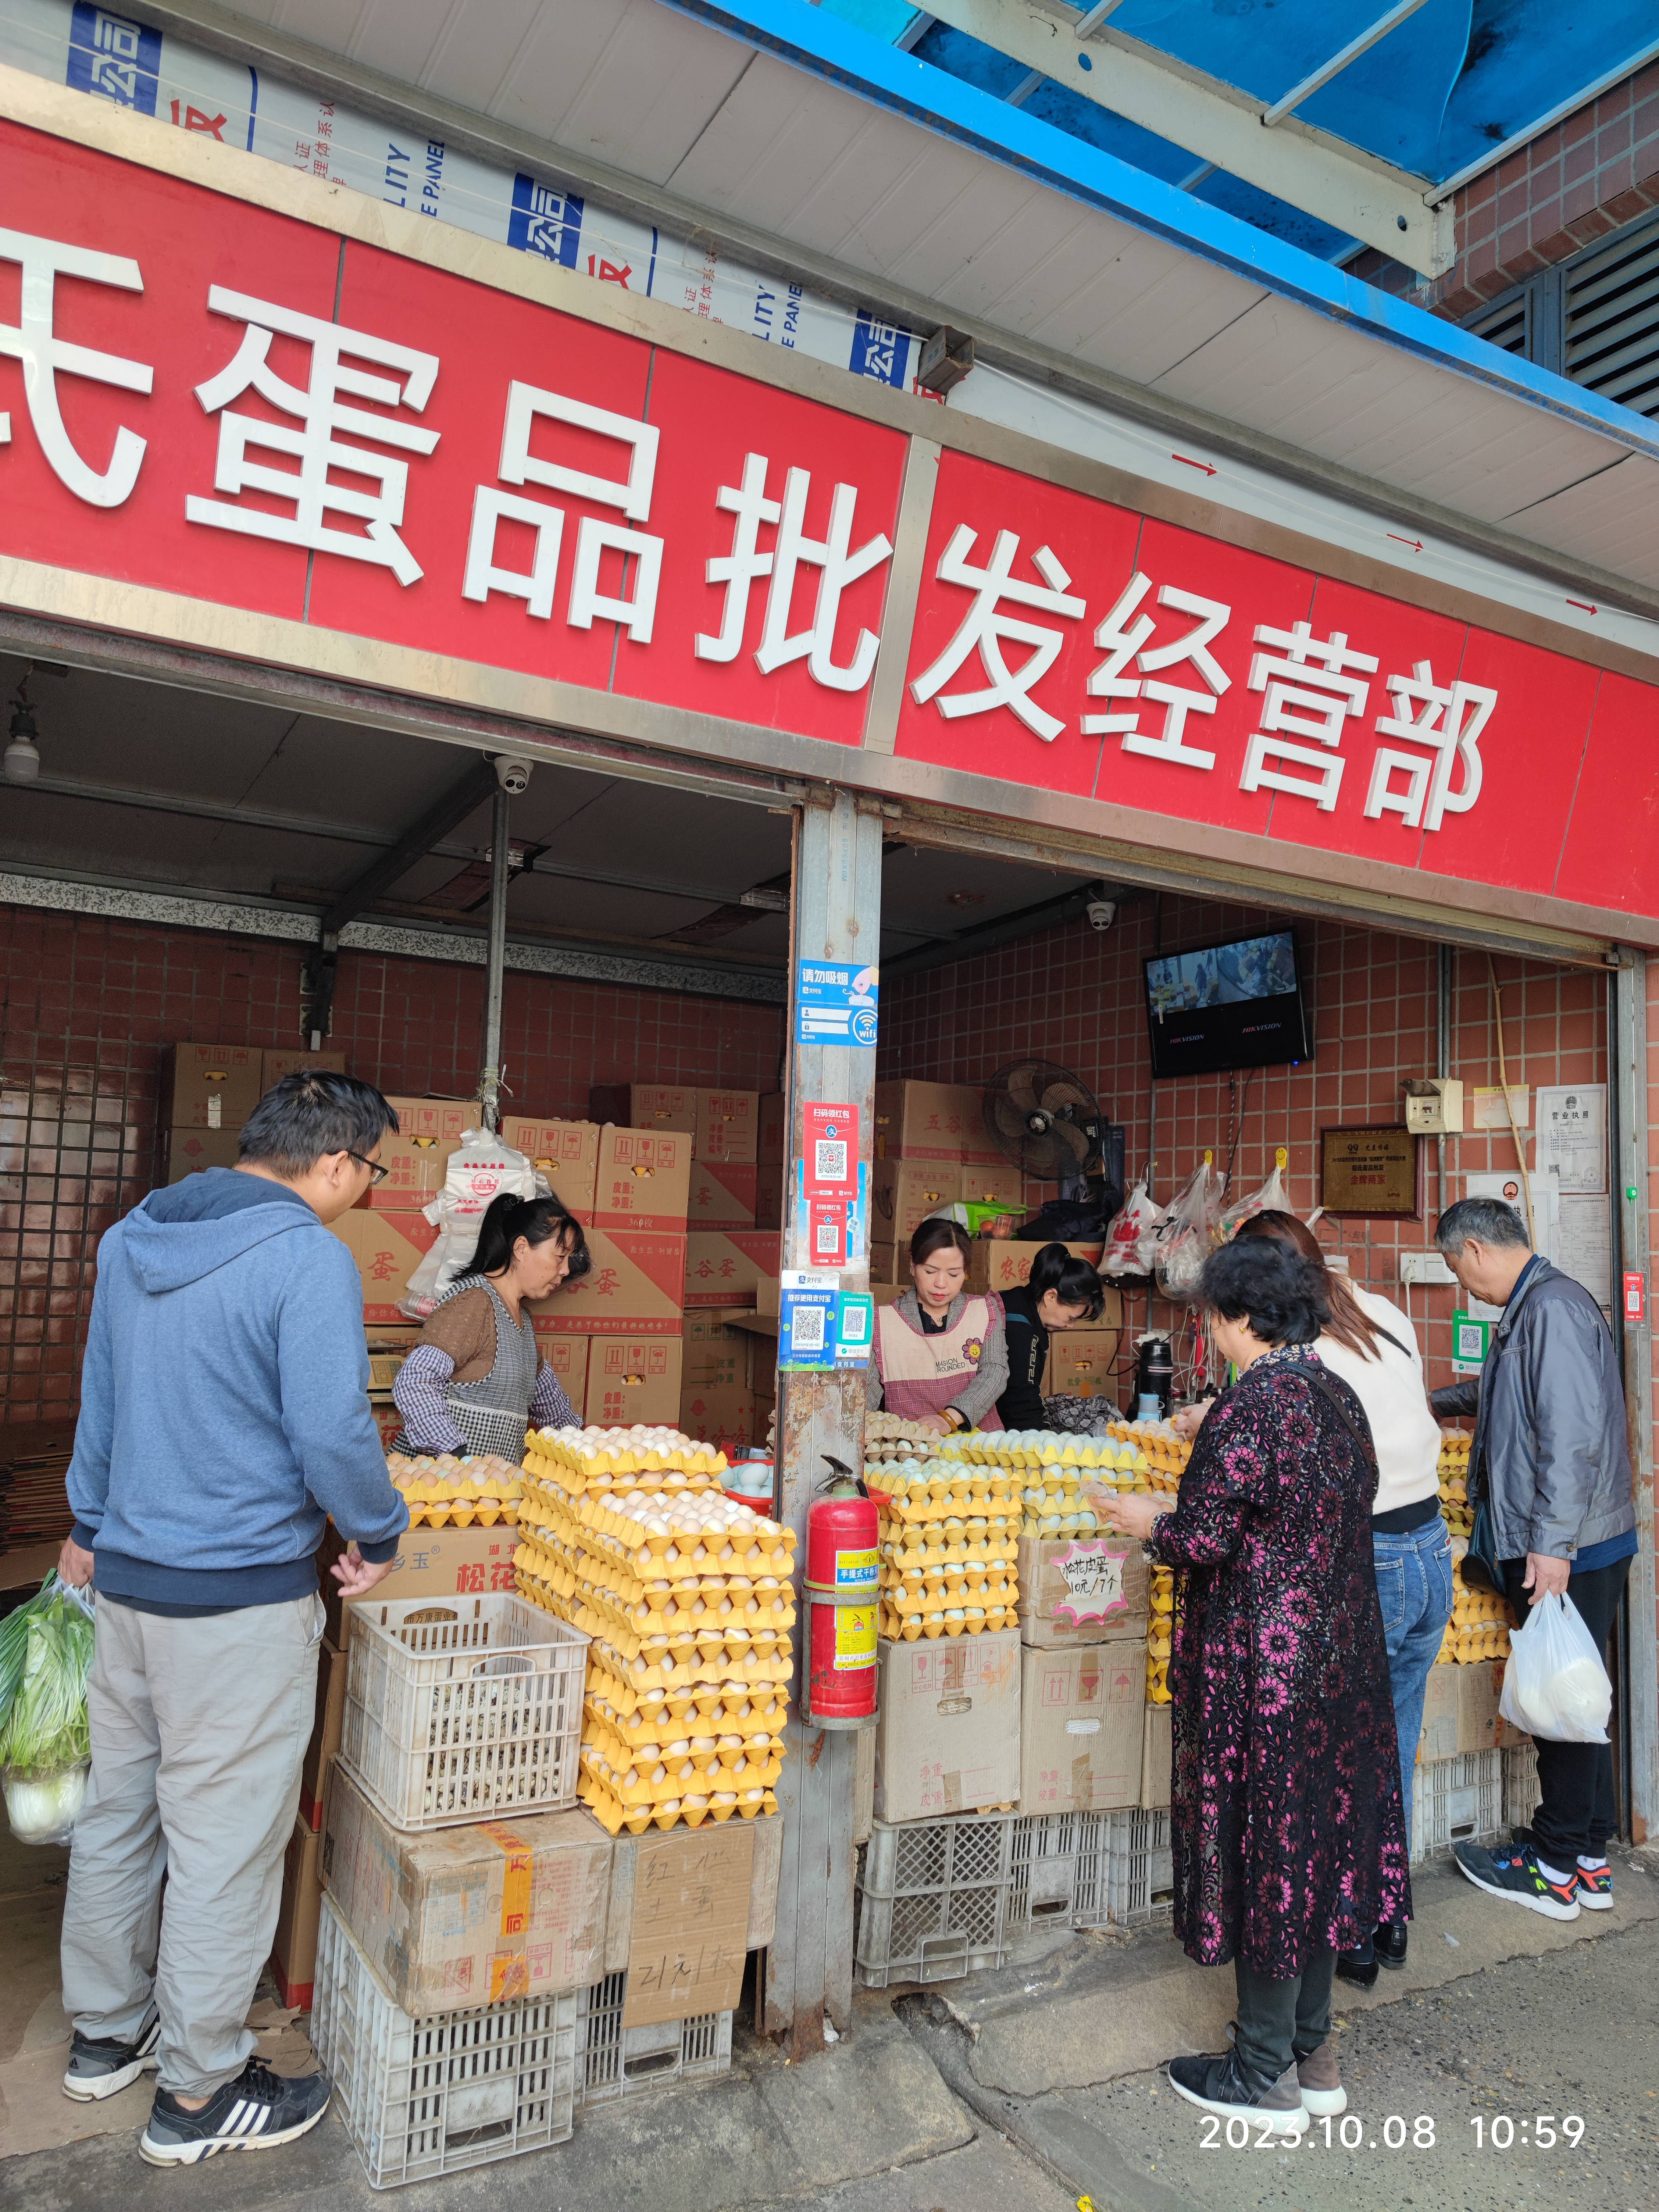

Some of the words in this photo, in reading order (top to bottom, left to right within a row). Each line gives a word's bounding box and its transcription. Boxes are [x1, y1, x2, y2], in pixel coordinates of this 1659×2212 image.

[802, 968, 848, 985] 请勿吸烟
[859, 1029, 877, 1038] wifi
[1243, 1022, 1282, 1034] HIKVISION
[1170, 1034, 1205, 1044] HIKVISION
[813, 1107, 850, 1119] 扫码领红包
[1552, 1111, 1589, 1120] 营业执照
[1347, 1144, 1359, 1152] QQ
[391, 1156, 416, 1169] 皮重:
[390, 1172, 415, 1185] 净重:
[1351, 1174, 1386, 1185] 金牌商家
[613, 1181, 634, 1194] 皮重:
[611, 1196, 633, 1209] 净重:
[628, 1218, 653, 1228] 360枚
[410, 1227, 438, 1237] 原生态
[630, 1245, 653, 1255] 原生态
[787, 1294, 832, 1303] 推荐使用支付宝
[935, 1357, 958, 1367] MASION
[937, 1362, 966, 1373] ROUNDED
[604, 1392, 625, 1405] 皮重:
[603, 1407, 625, 1420] 净重:
[488, 1543, 518, 1556] 湖北
[1062, 1555, 1110, 1577] 松花皮蛋
[456, 1562, 517, 1593] 松花
[1071, 1574, 1119, 1595] 10元/7个
[913, 1683, 932, 1691] 小心轻放
[920, 1763, 943, 1779] 净重
[920, 1791, 943, 1806] 皮重
[528, 1945, 550, 1955] 小心轻放
